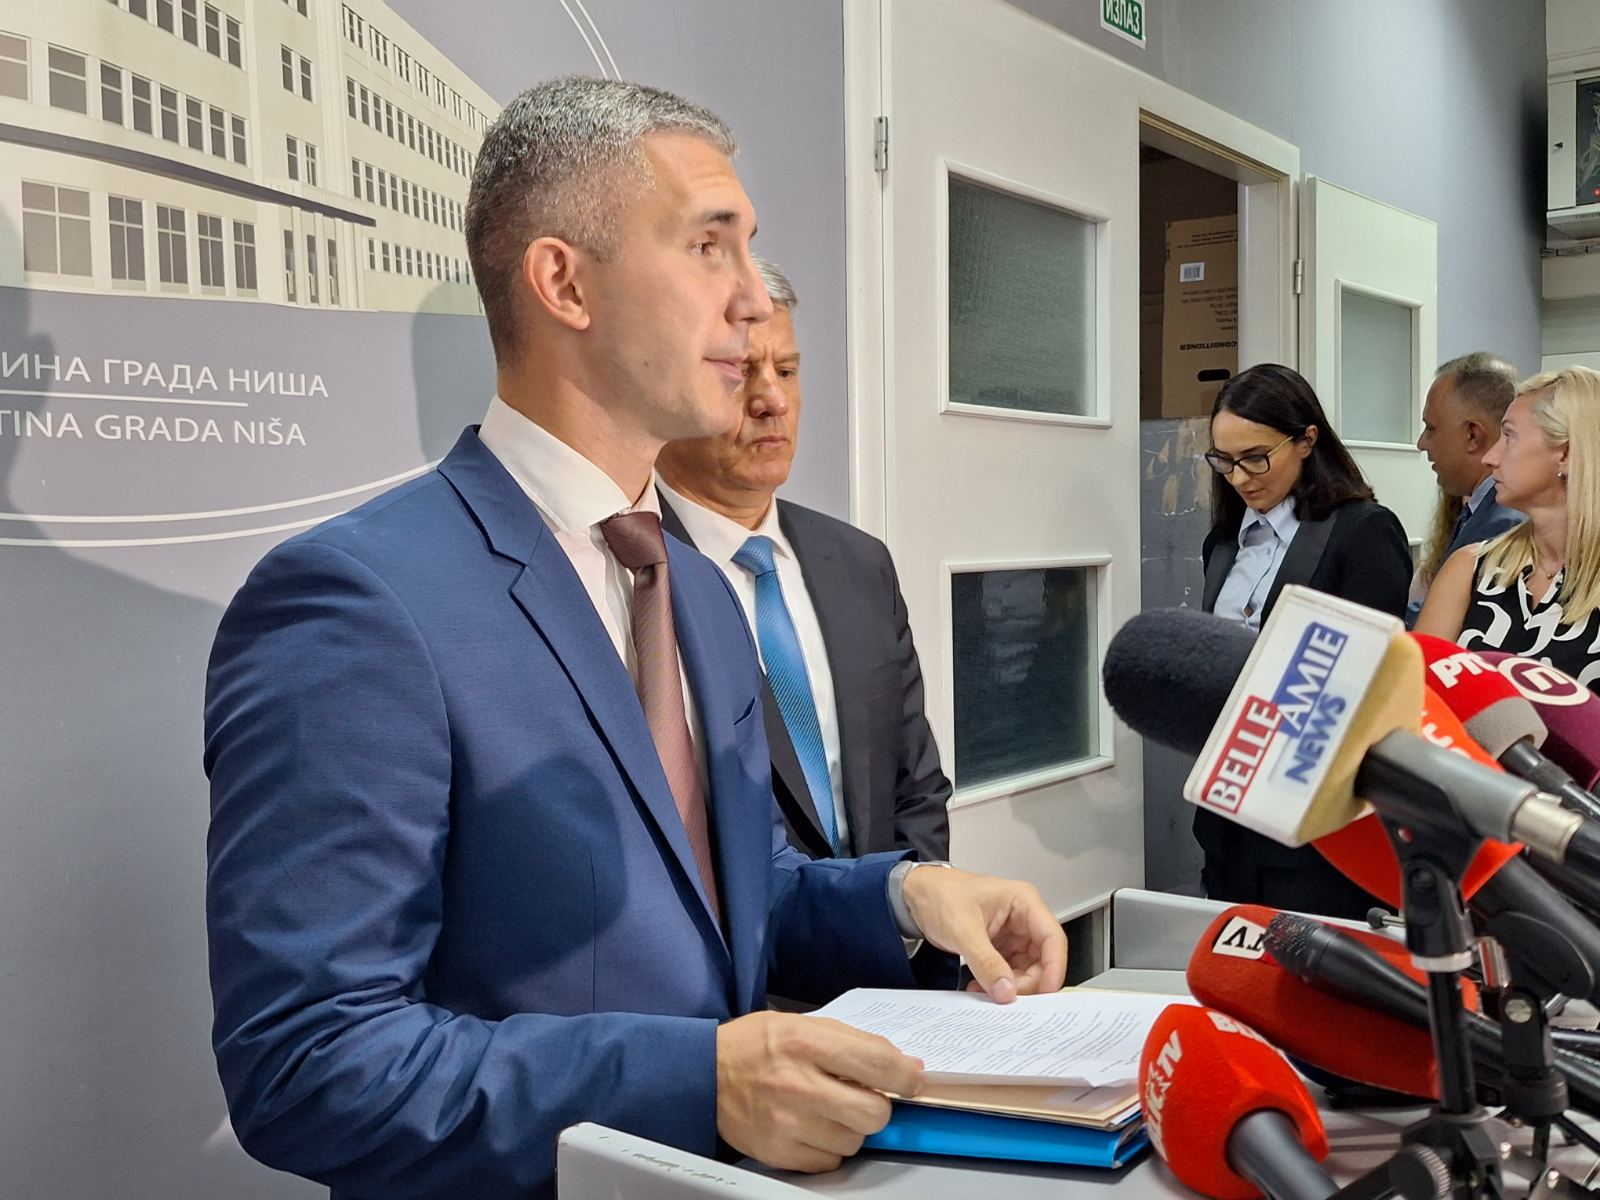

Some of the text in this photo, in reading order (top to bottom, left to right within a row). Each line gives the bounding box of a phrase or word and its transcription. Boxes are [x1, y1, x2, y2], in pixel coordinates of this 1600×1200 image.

[1105, 0, 1140, 35] ИЗЛАЗ
[1, 351, 329, 398] ИНА ГРАДА НИША
[94, 414, 224, 444] GRADA
[234, 416, 307, 446] NIŠA
[1206, 626, 1344, 812] BELLE AMIE
[1284, 694, 1347, 785] NEWS
[1156, 1029, 1183, 1079] TV
